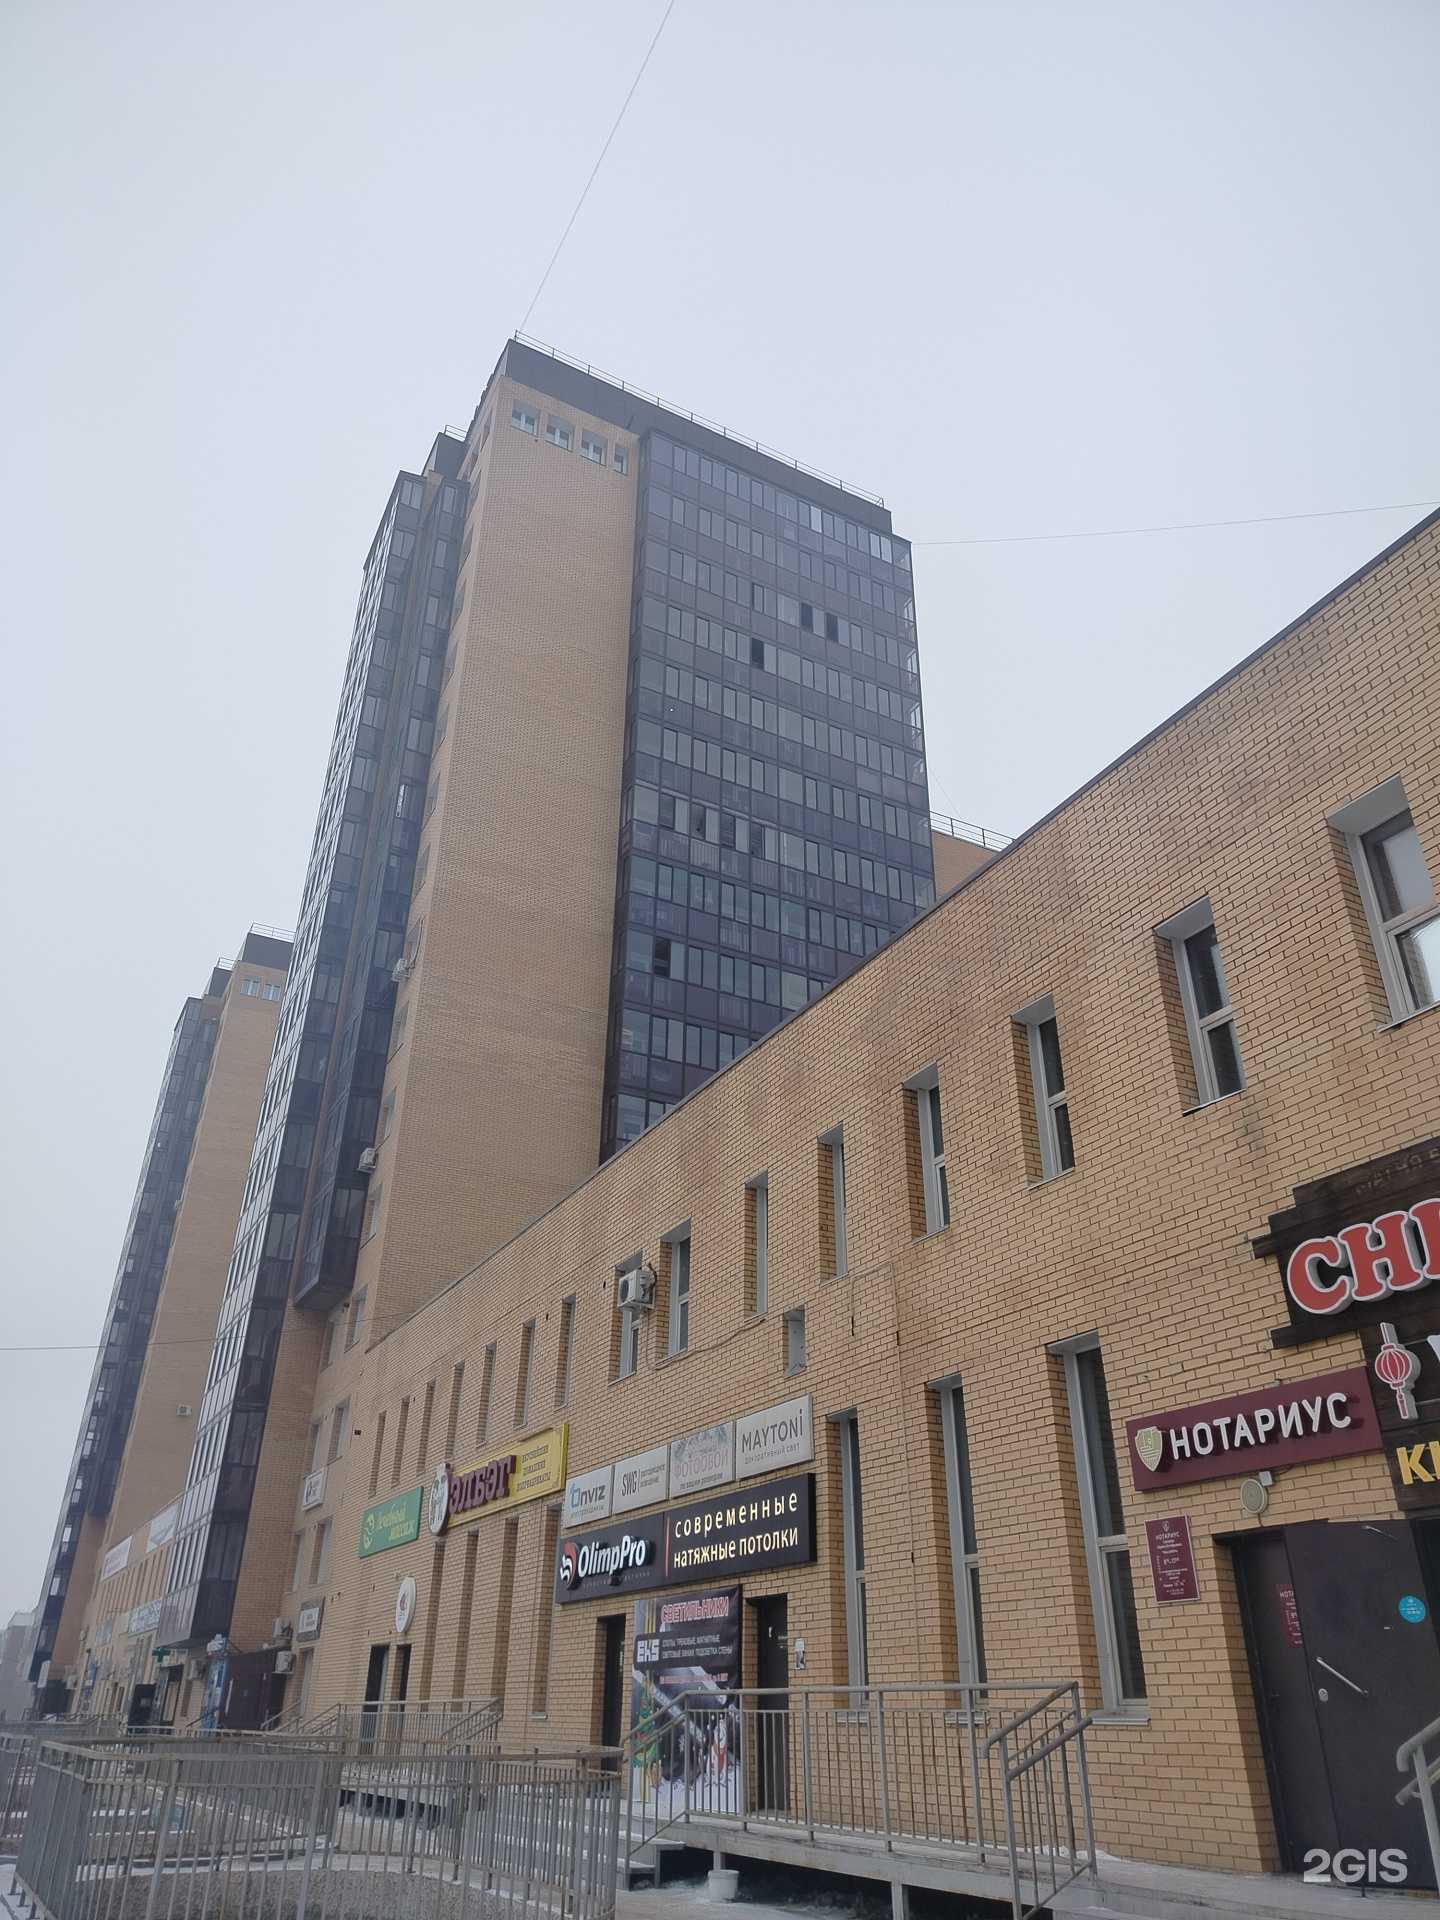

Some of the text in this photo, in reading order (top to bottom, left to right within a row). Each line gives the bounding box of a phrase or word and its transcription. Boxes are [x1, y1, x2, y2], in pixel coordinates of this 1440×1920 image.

[1170, 1393, 1351, 1460] НОТАРИУС
[676, 1492, 797, 1538] современные
[578, 1535, 646, 1577] OlimpPro
[674, 1527, 799, 1568] натяжные потолки
[661, 1596, 729, 1624] СВЕТИЛЬНИКИ
